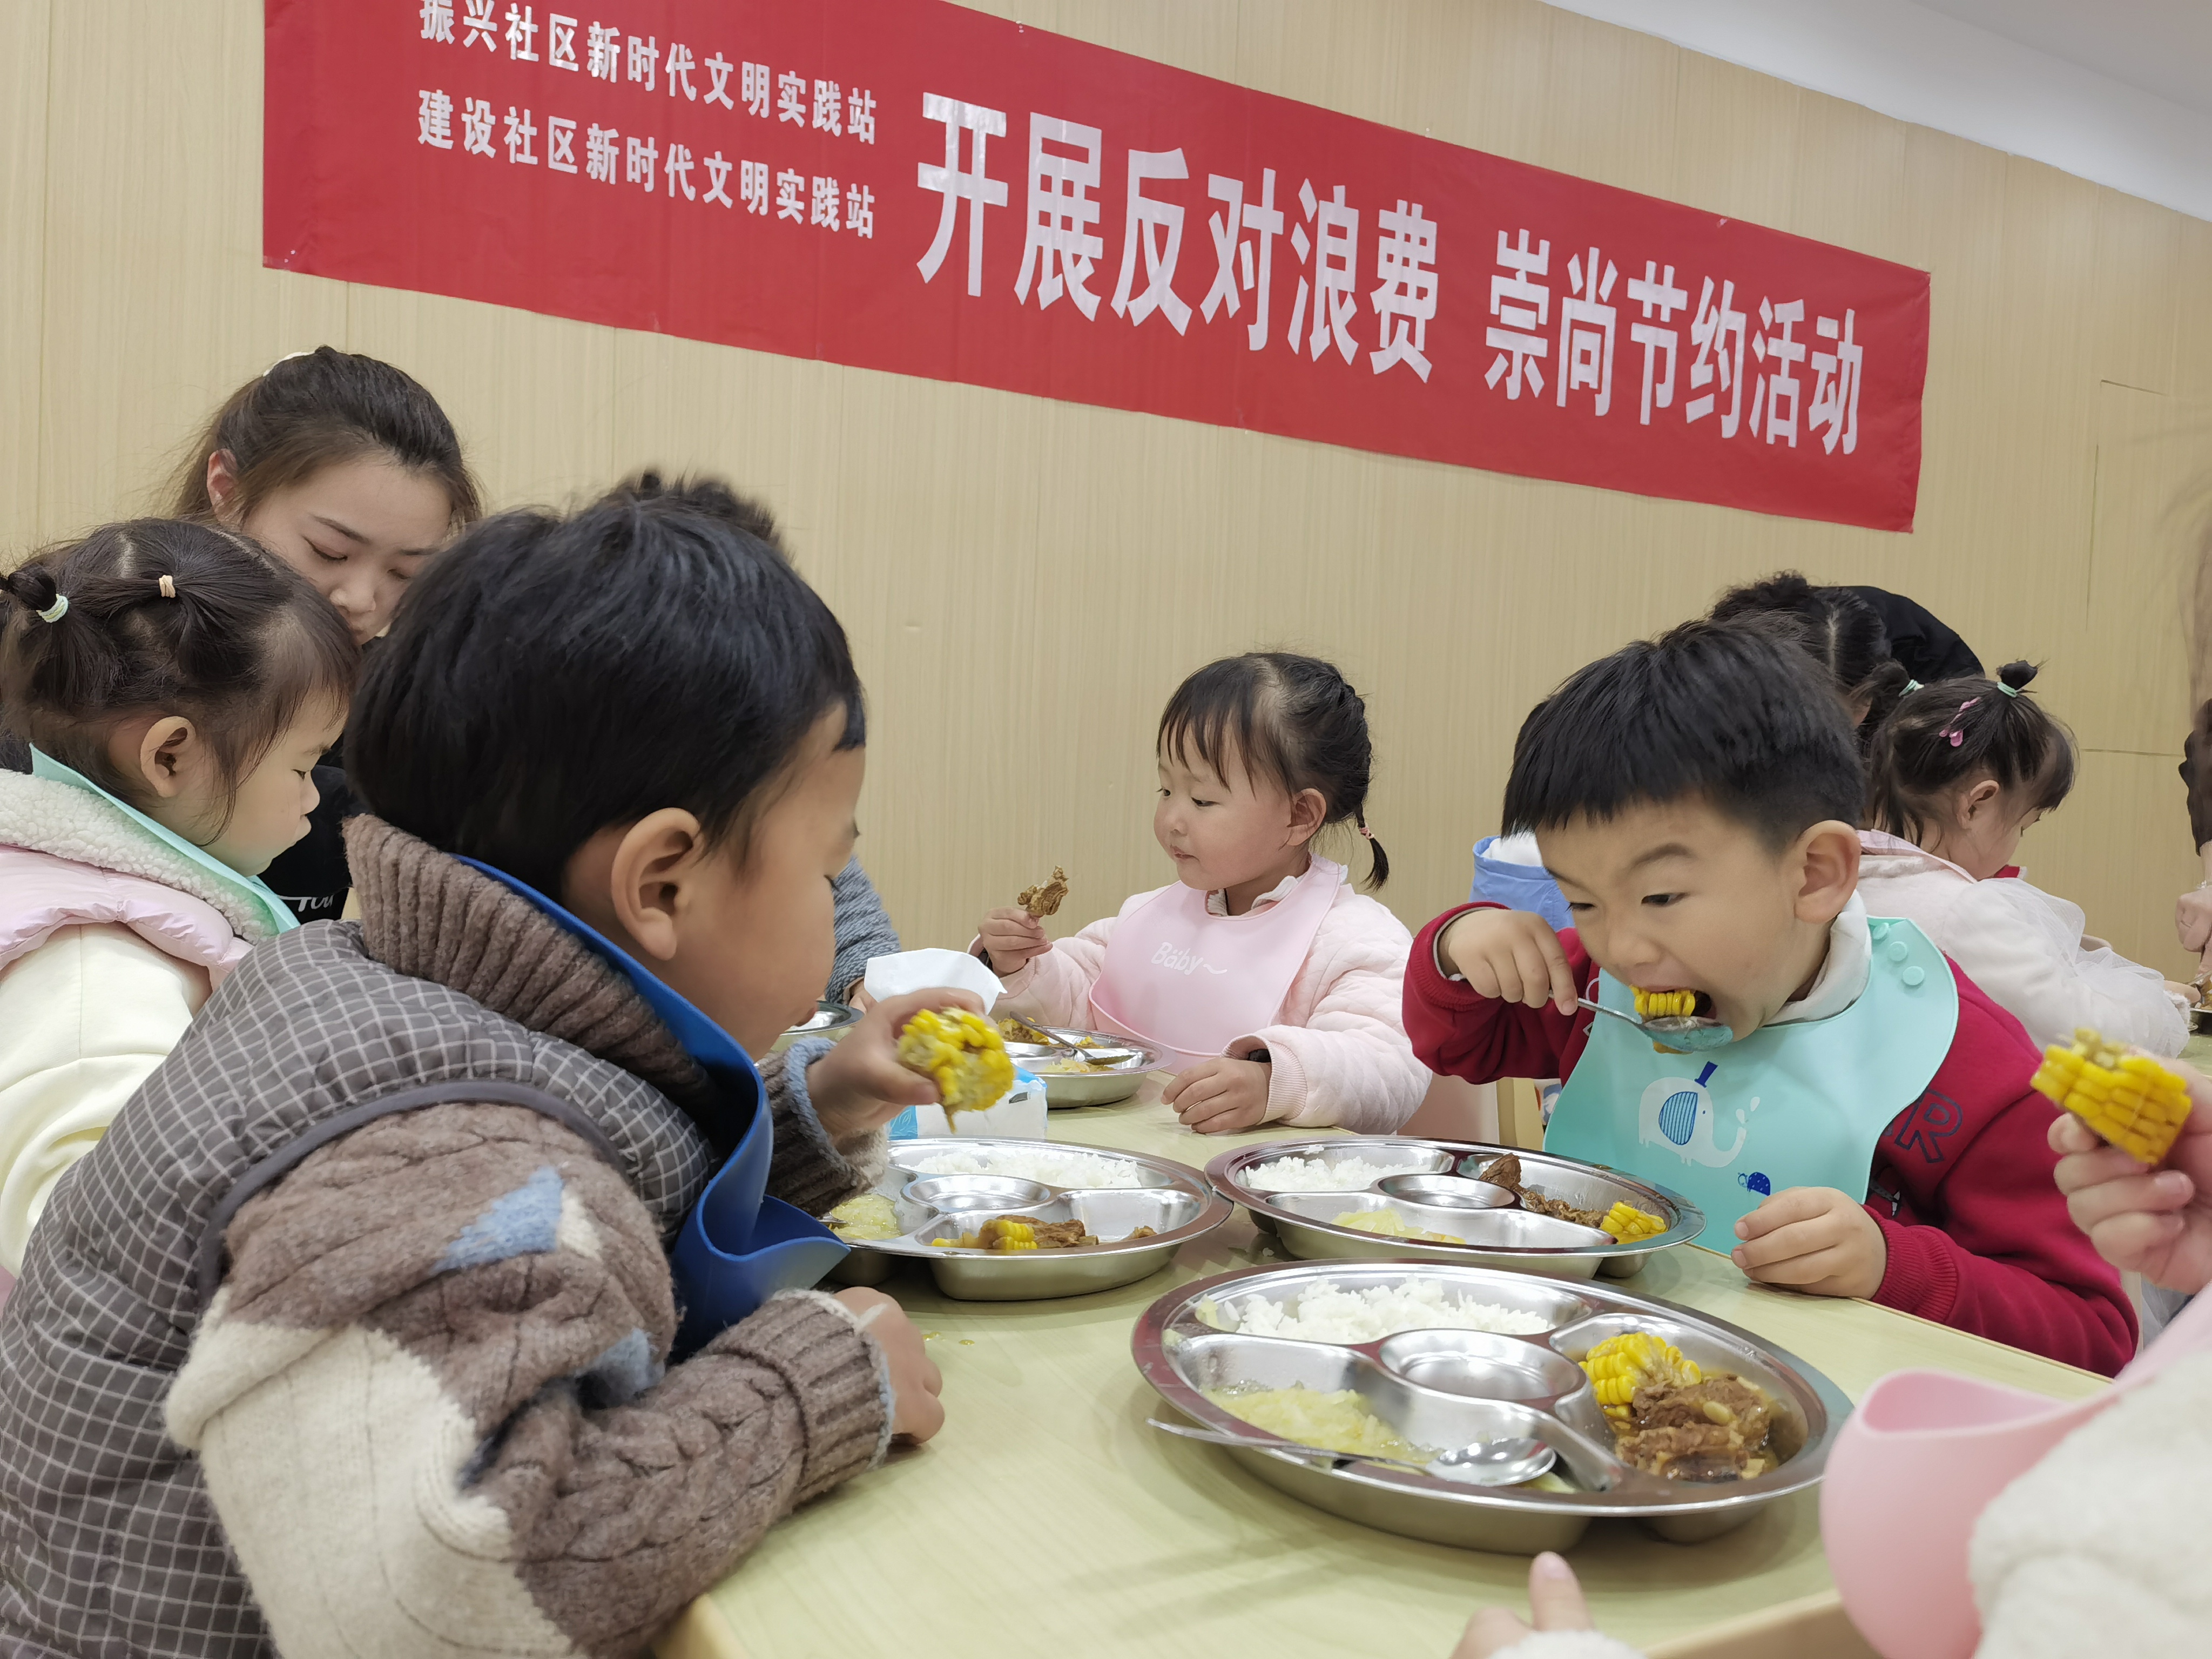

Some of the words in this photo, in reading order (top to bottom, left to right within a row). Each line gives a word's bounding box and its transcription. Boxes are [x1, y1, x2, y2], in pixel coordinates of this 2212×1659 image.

[419, 0, 876, 145] 振兴社区新时代文明实践站
[417, 89, 875, 239] 建设社区新时代文明实践站
[916, 92, 1439, 383] 开展反对浪费
[1485, 228, 1864, 455] 崇尚节约活动
